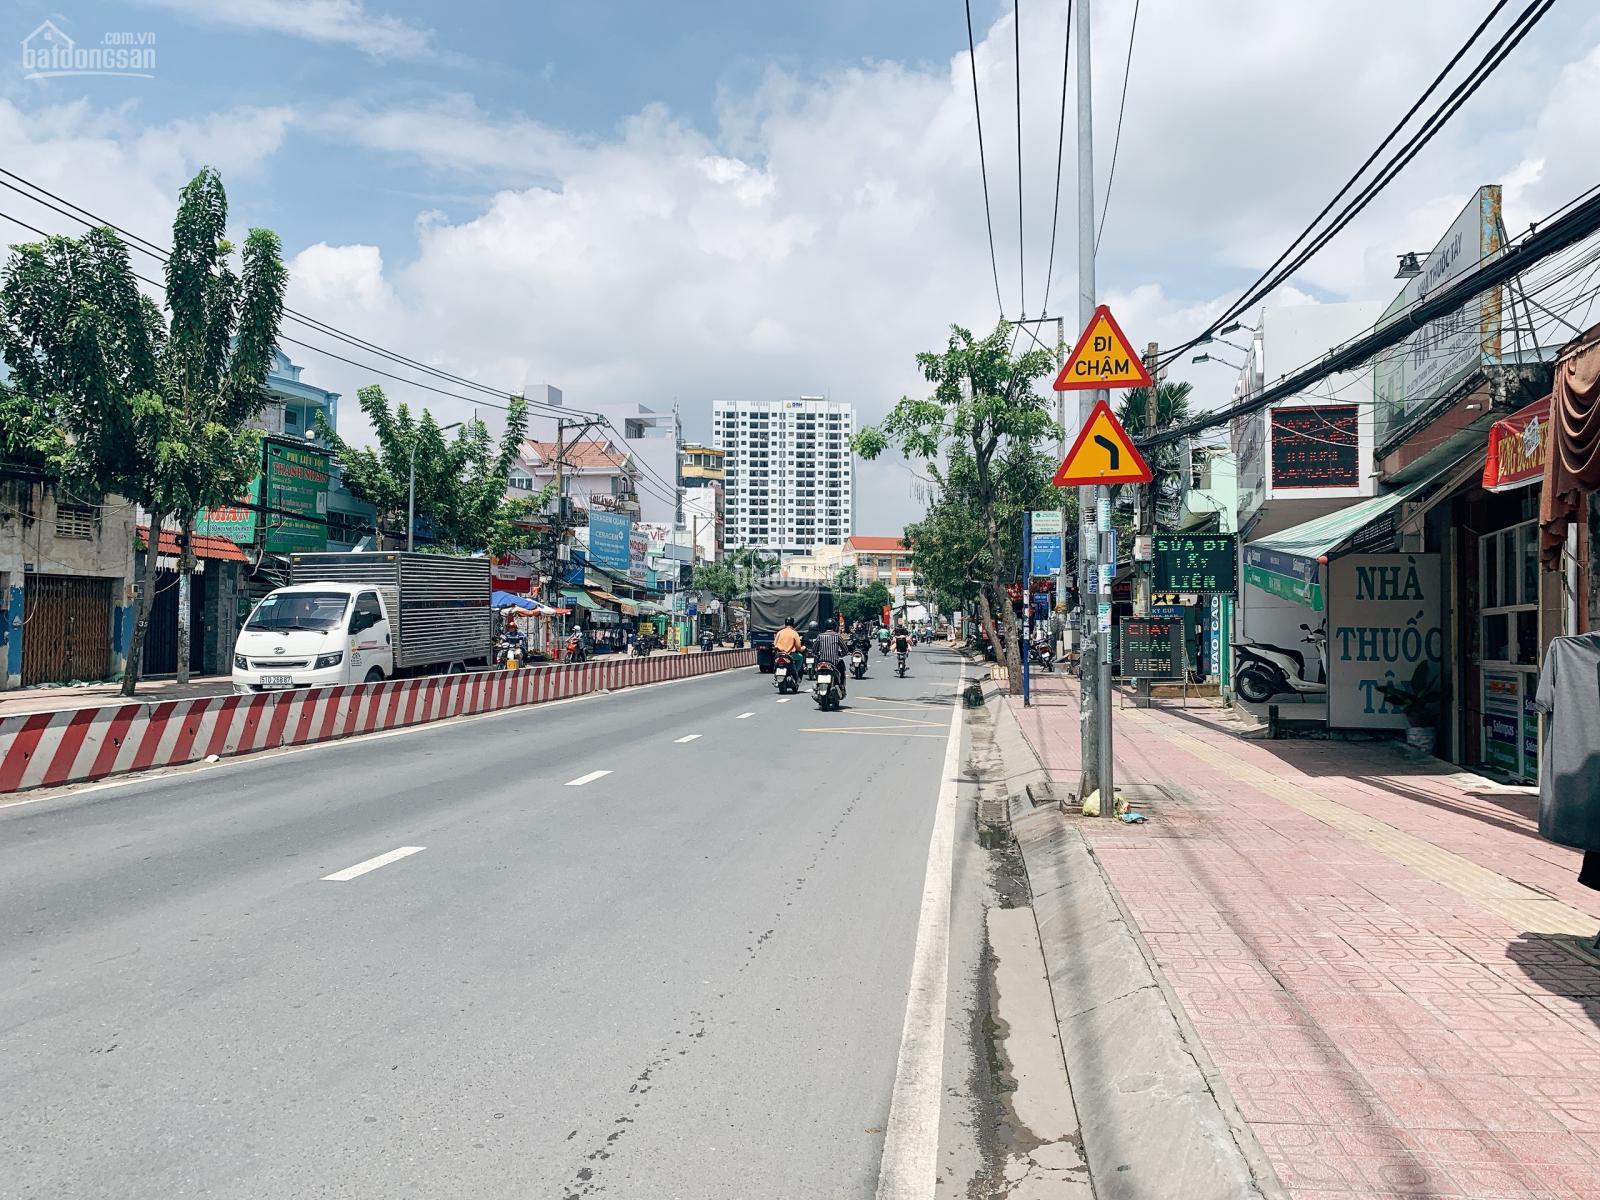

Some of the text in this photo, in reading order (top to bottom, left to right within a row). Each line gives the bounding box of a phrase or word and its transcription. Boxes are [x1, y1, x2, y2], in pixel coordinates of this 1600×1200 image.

[1093, 336, 1112, 352] ĐI
[1075, 356, 1130, 379] CHẬM
[1355, 555, 1425, 601] NHÀ
